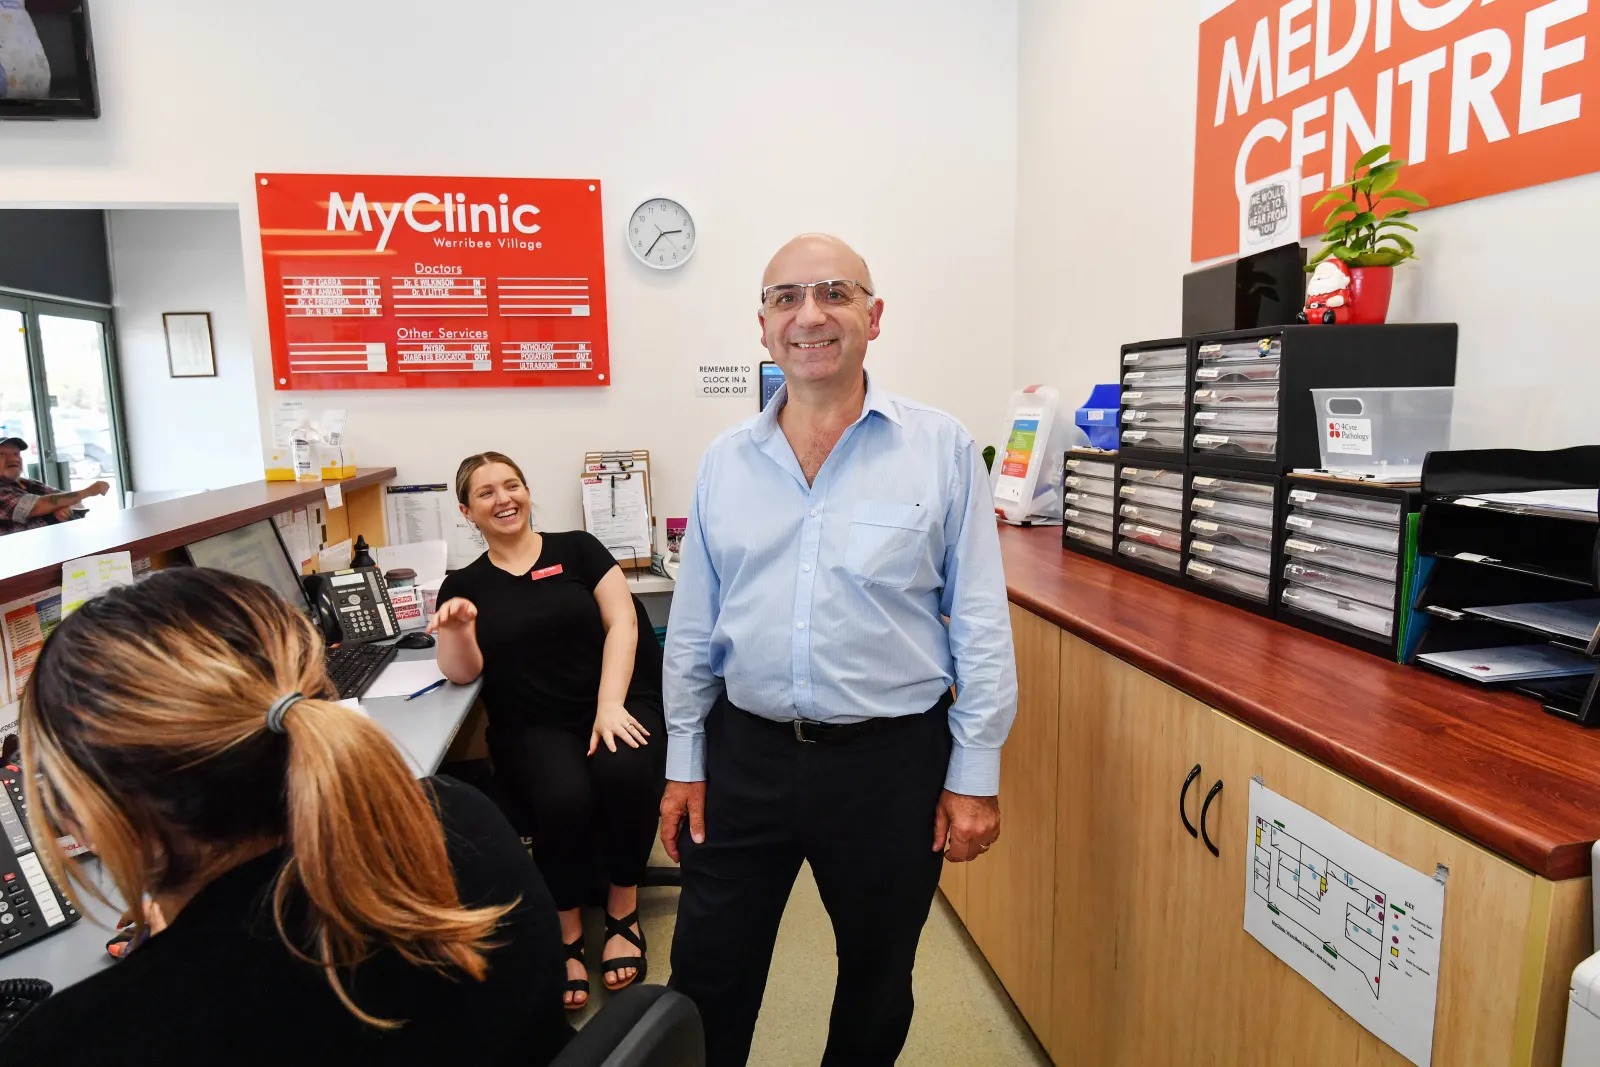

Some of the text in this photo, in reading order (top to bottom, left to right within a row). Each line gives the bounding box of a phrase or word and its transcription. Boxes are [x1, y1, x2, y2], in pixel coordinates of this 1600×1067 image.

[1214, 0, 1510, 127] MEDI
[1234, 0, 1589, 203] CENTRE
[1261, 186, 1285, 202] WOULD
[1253, 198, 1281, 215] LOVE TO
[326, 191, 541, 252] MyClinic
[1249, 206, 1287, 227] HEAR FROM
[1260, 222, 1275, 235] YOU
[433, 237, 543, 251] Werribee Village
[415, 262, 462, 274] Doctors
[367, 288, 375, 296] IN
[365, 298, 379, 306] OUT
[397, 327, 488, 339] Other Services
[403, 353, 488, 361] DIABETES EDUCATOR OUT
[699, 365, 751, 373] REMEMBER TO
[703, 386, 747, 394] CLOCK OUT
[1341, 422, 1358, 431] 4Cyte
[1341, 430, 1369, 442] Pathology
